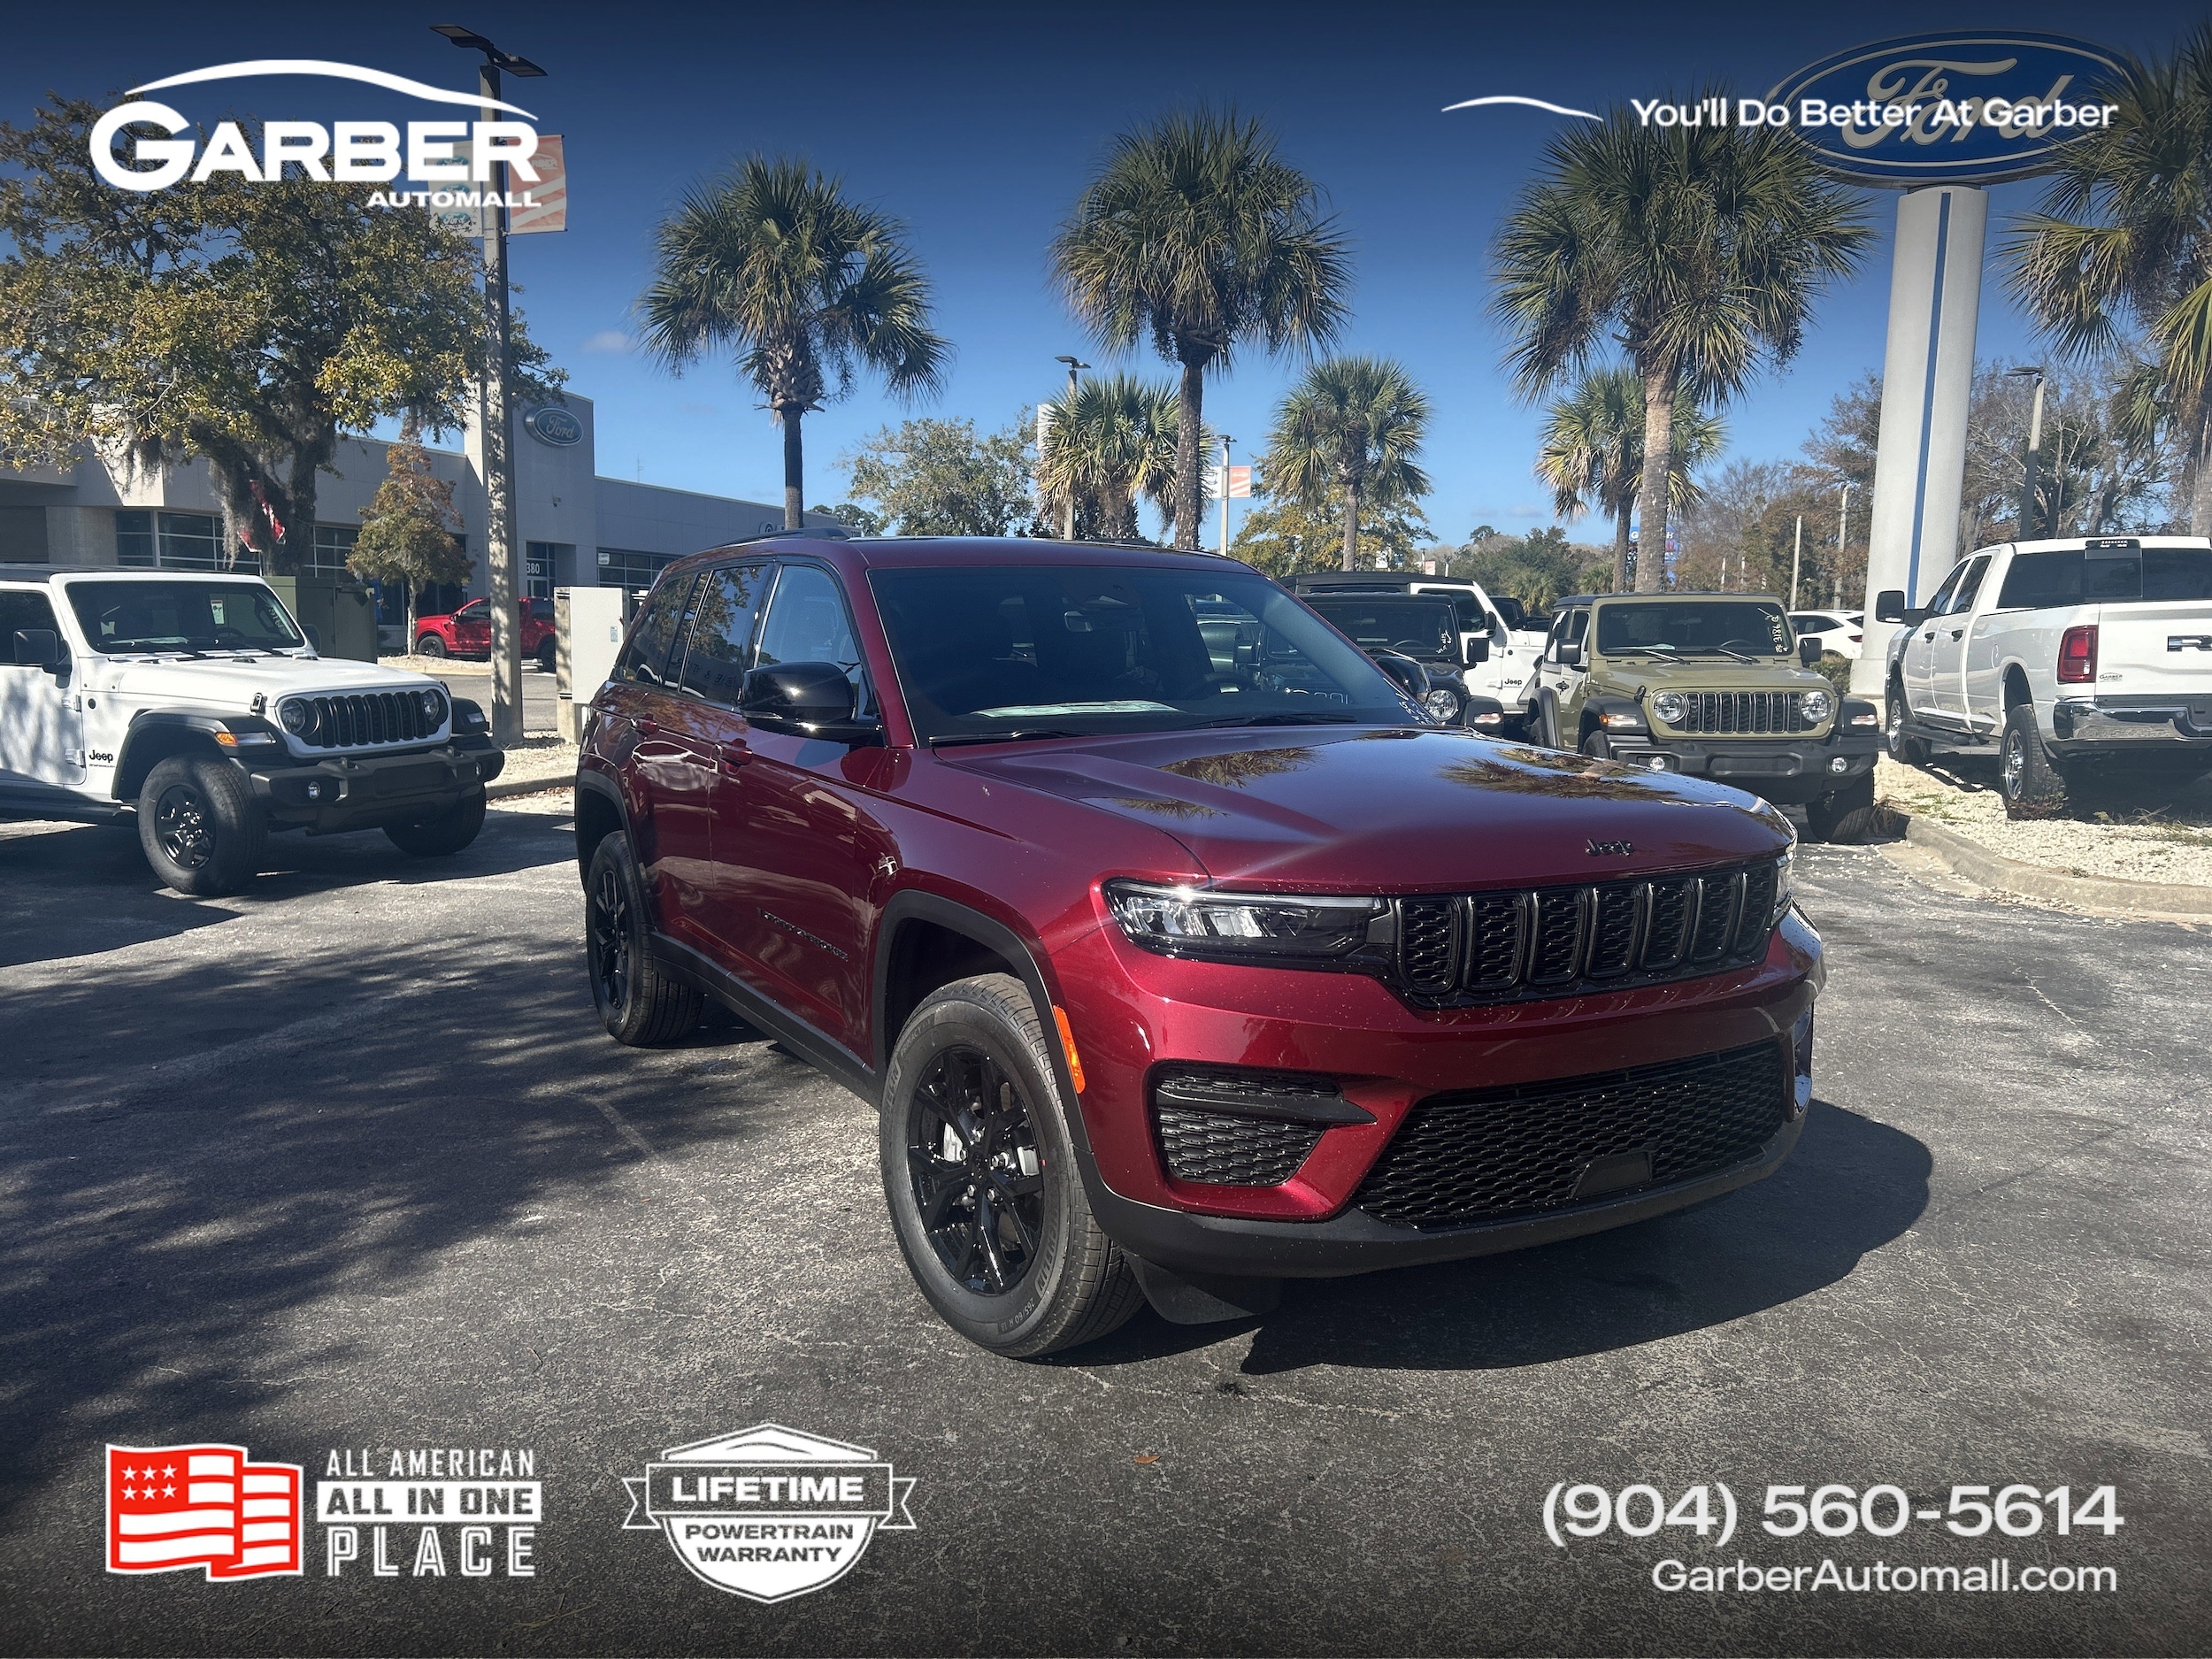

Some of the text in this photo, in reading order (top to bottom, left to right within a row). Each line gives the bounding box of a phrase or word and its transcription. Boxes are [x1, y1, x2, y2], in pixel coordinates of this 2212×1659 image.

[1842, 58, 2075, 149] Ford
[546, 414, 575, 439] Ford
[88, 749, 113, 764] Jeep
[1585, 838, 1634, 857] Jeep
